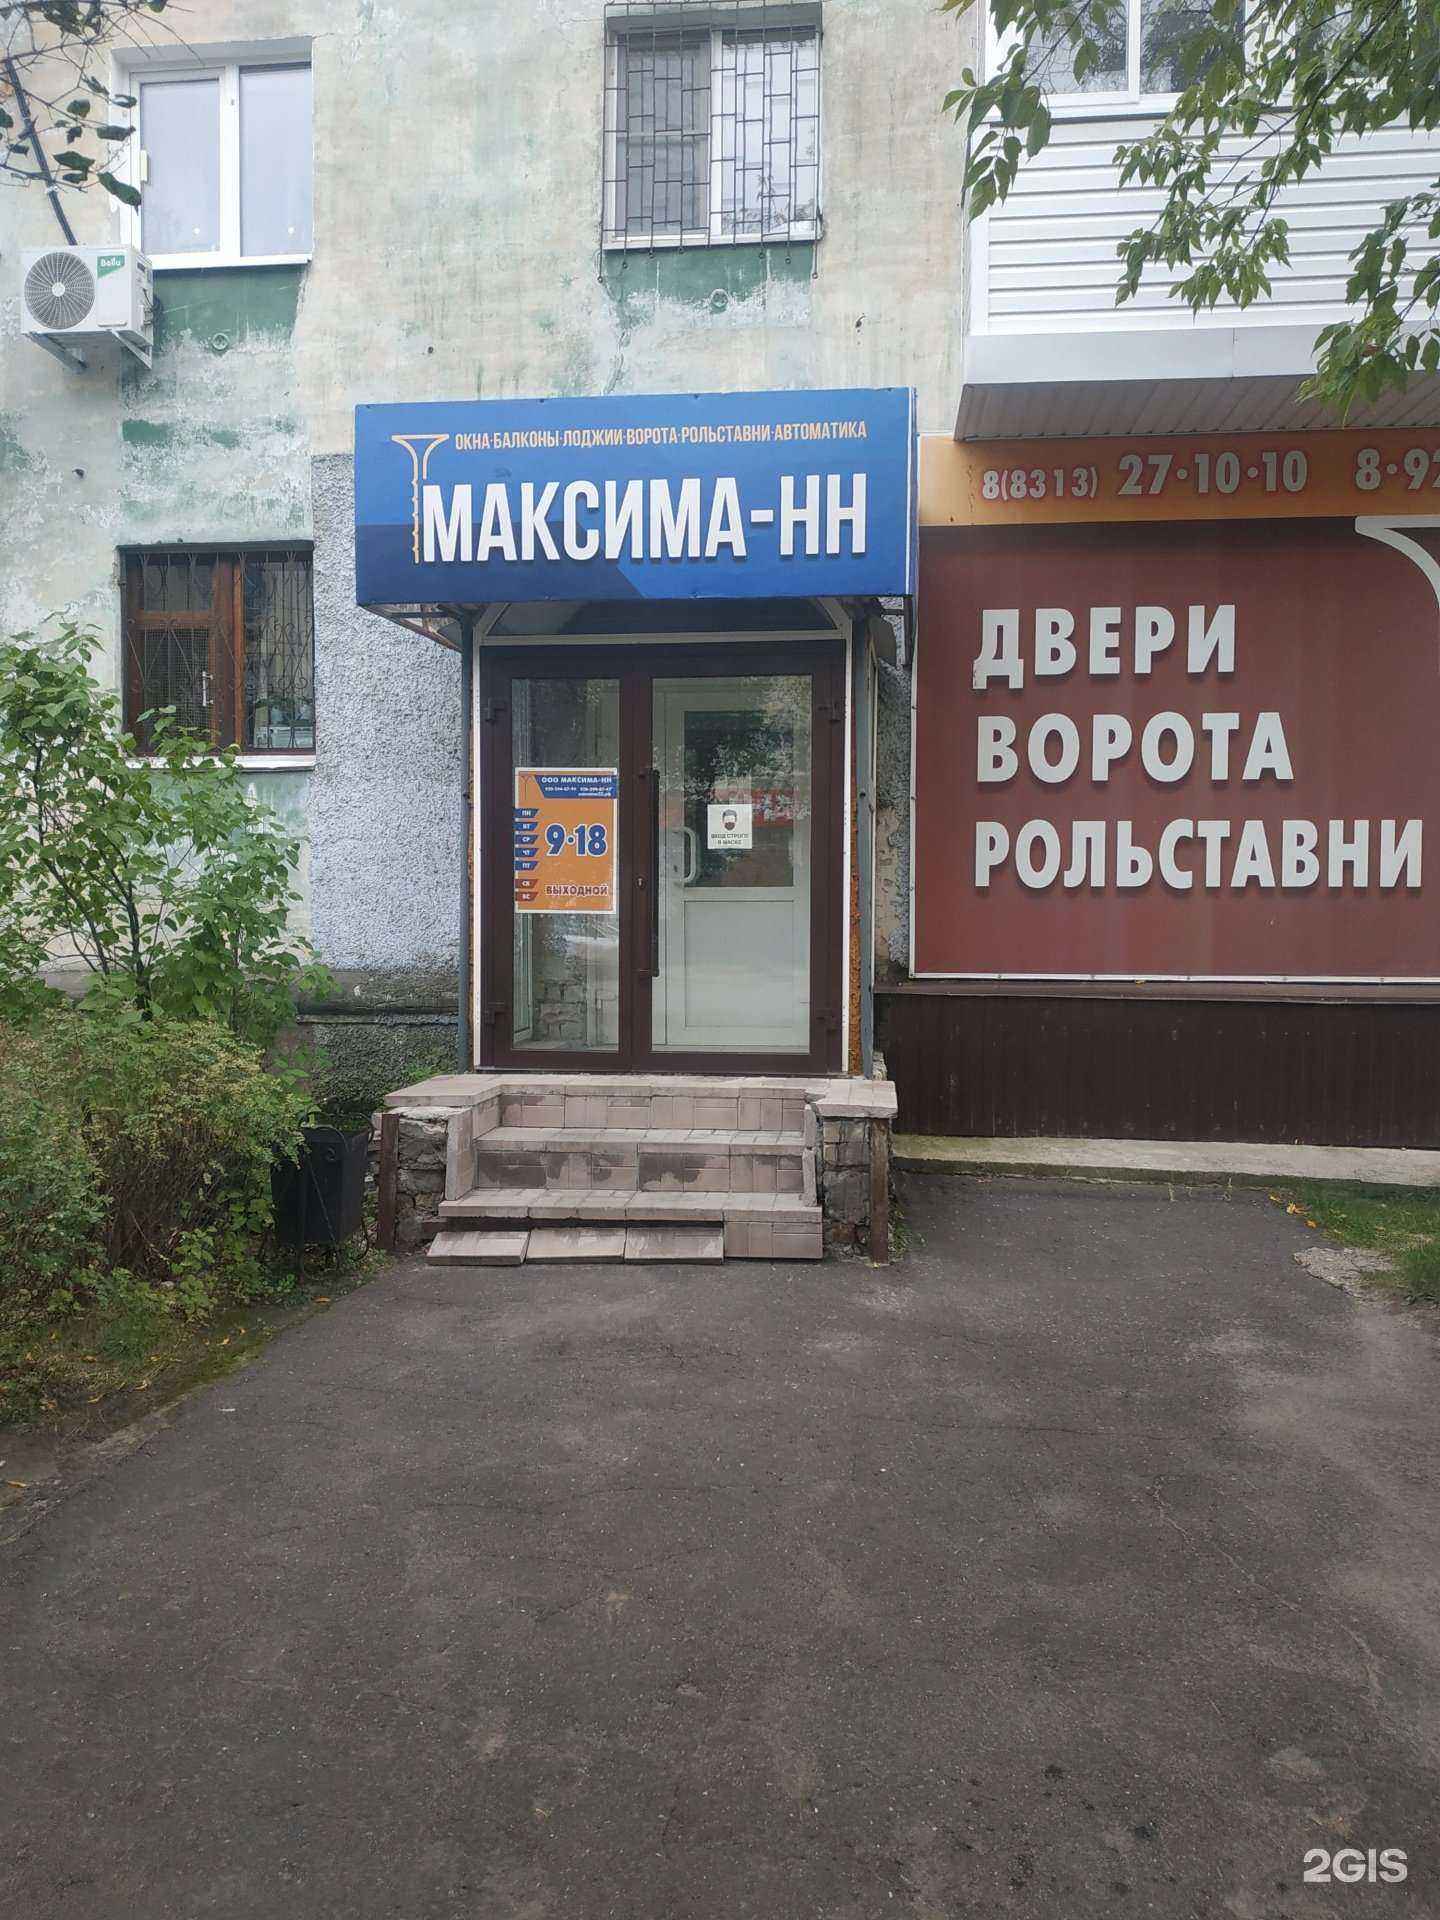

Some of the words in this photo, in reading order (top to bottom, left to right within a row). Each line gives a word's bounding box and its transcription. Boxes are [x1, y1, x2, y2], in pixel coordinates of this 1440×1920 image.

[422, 473, 868, 563] МАКСИМА-НН
[982, 466, 1098, 502] 8(8313)
[972, 604, 1237, 690] ДВЕРИ
[541, 776, 559, 784] ООО
[560, 776, 612, 784] МАКСИМА-НН
[977, 711, 1295, 784] ВОРОТА
[545, 883, 609, 897] ВЫХОДНОЙ
[974, 819, 1424, 890] РОЛЬСТАВНИ
